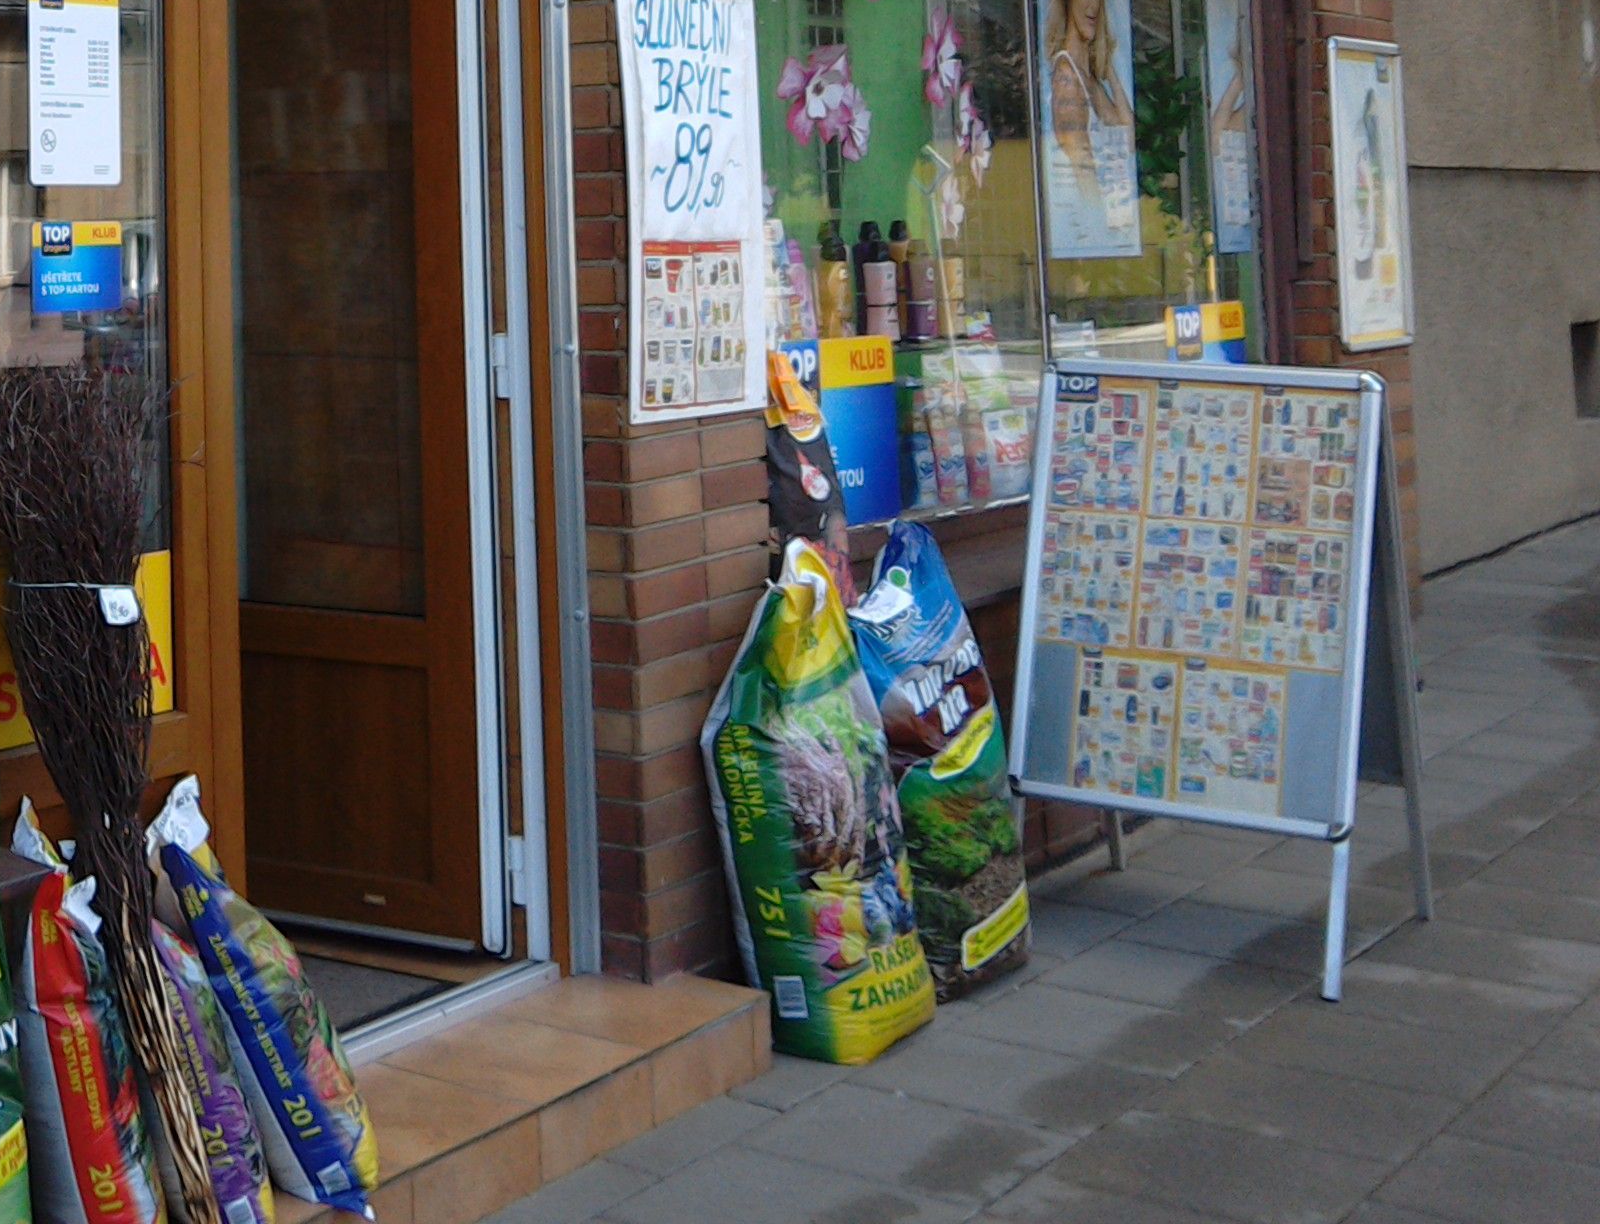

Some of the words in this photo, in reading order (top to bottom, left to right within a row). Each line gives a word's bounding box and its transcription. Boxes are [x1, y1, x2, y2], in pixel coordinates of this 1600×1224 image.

[651, 53, 733, 119] BRÝLE
[43, 225, 70, 243] TOP
[92, 227, 117, 239] KLUB
[41, 271, 83, 284] UŠETŘETE
[49, 284, 65, 295] TOP
[66, 283, 100, 294] KARTOU
[1175, 311, 1200, 339] TOP
[788, 349, 816, 382] OP
[849, 348, 886, 371] KLUB
[1058, 376, 1097, 391] TOP
[282, 1094, 314, 1127] 20
[201, 1122, 228, 1156] 20
[88, 1163, 117, 1198] 20
